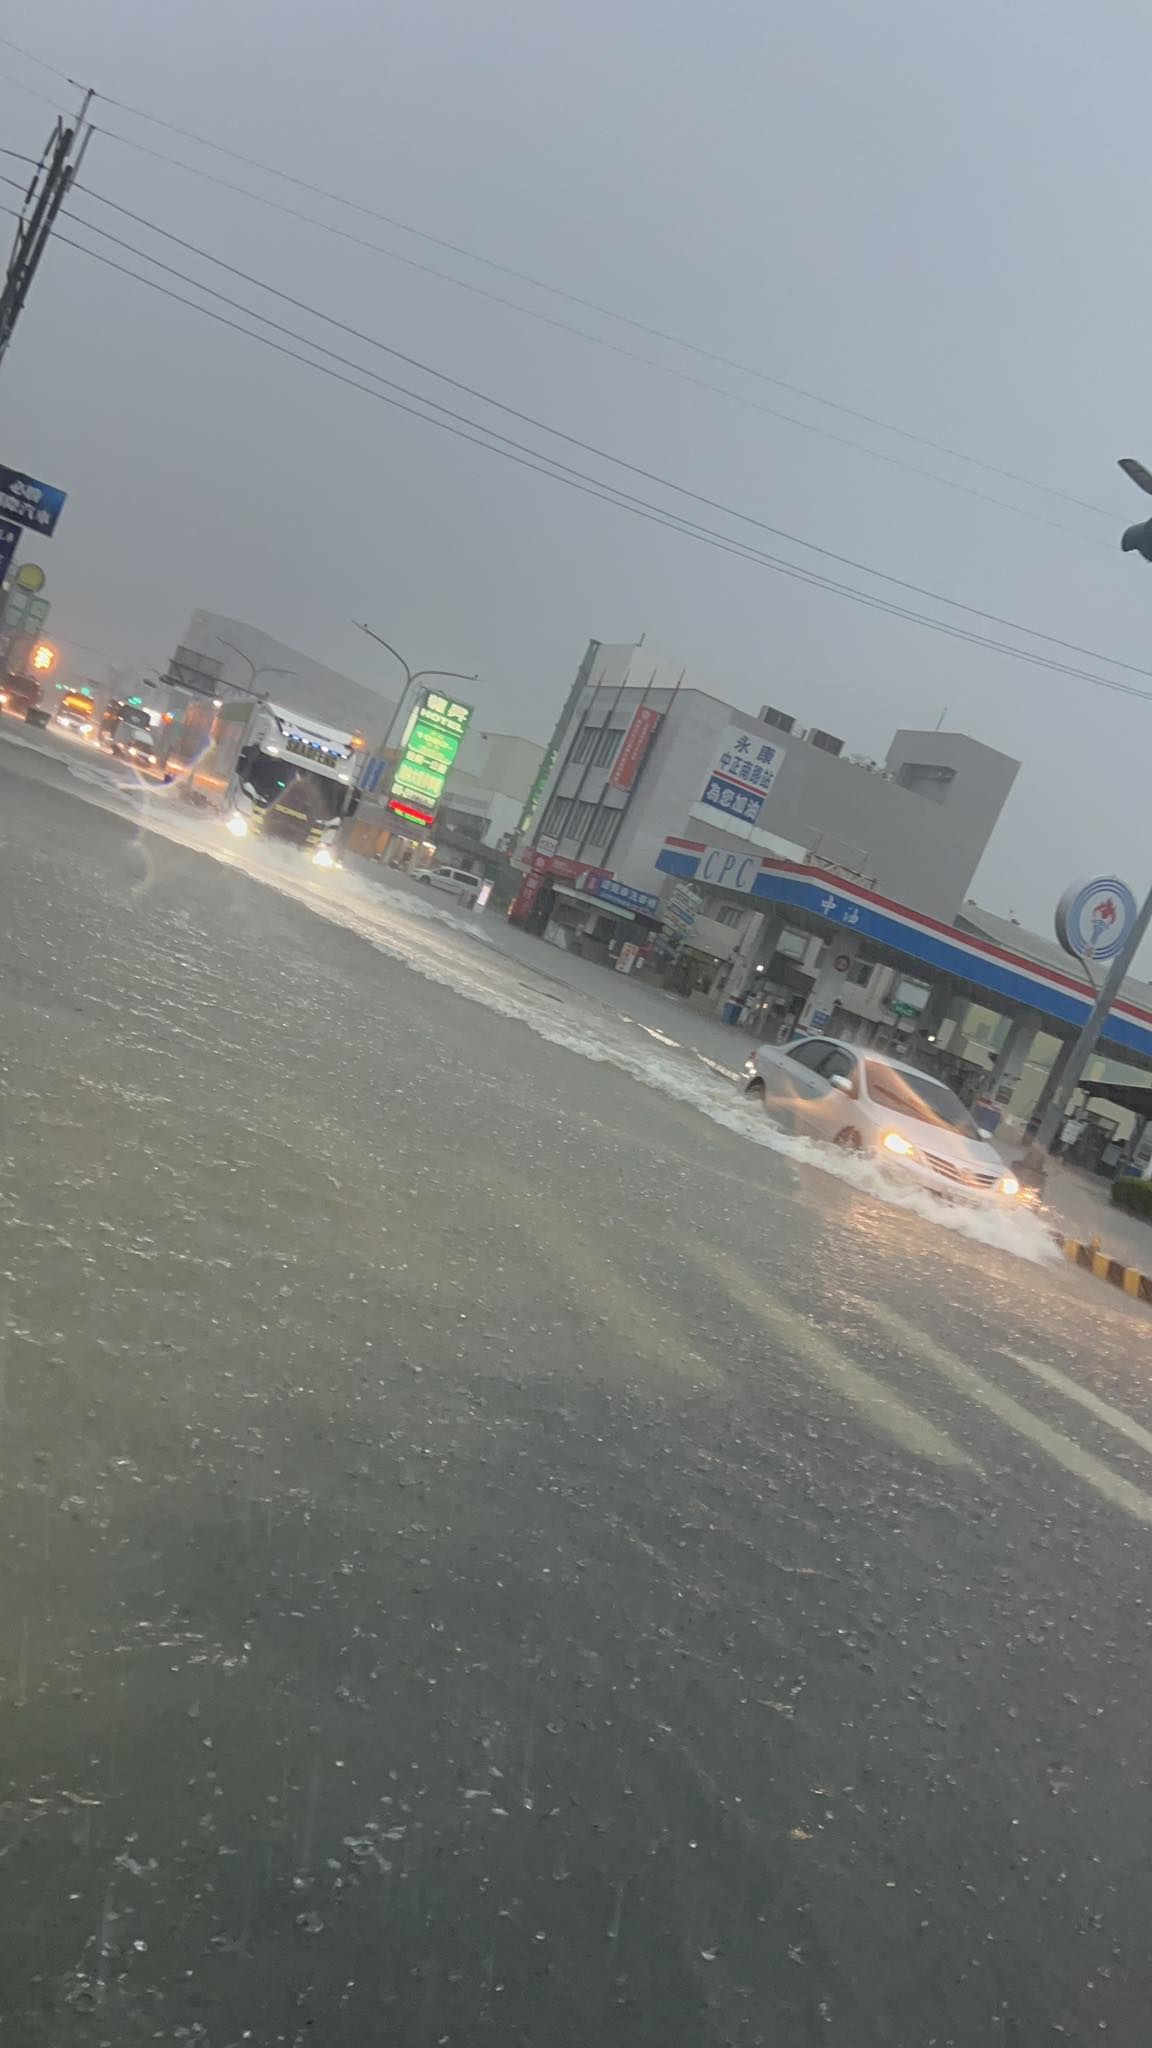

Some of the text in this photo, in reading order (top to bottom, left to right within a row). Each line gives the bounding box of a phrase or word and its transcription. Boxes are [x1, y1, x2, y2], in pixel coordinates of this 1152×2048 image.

[420, 707, 464, 734] HOTEL
[733, 735, 777, 765] 永康
[703, 850, 753, 888] CPC
[820, 894, 861, 925] 中油
